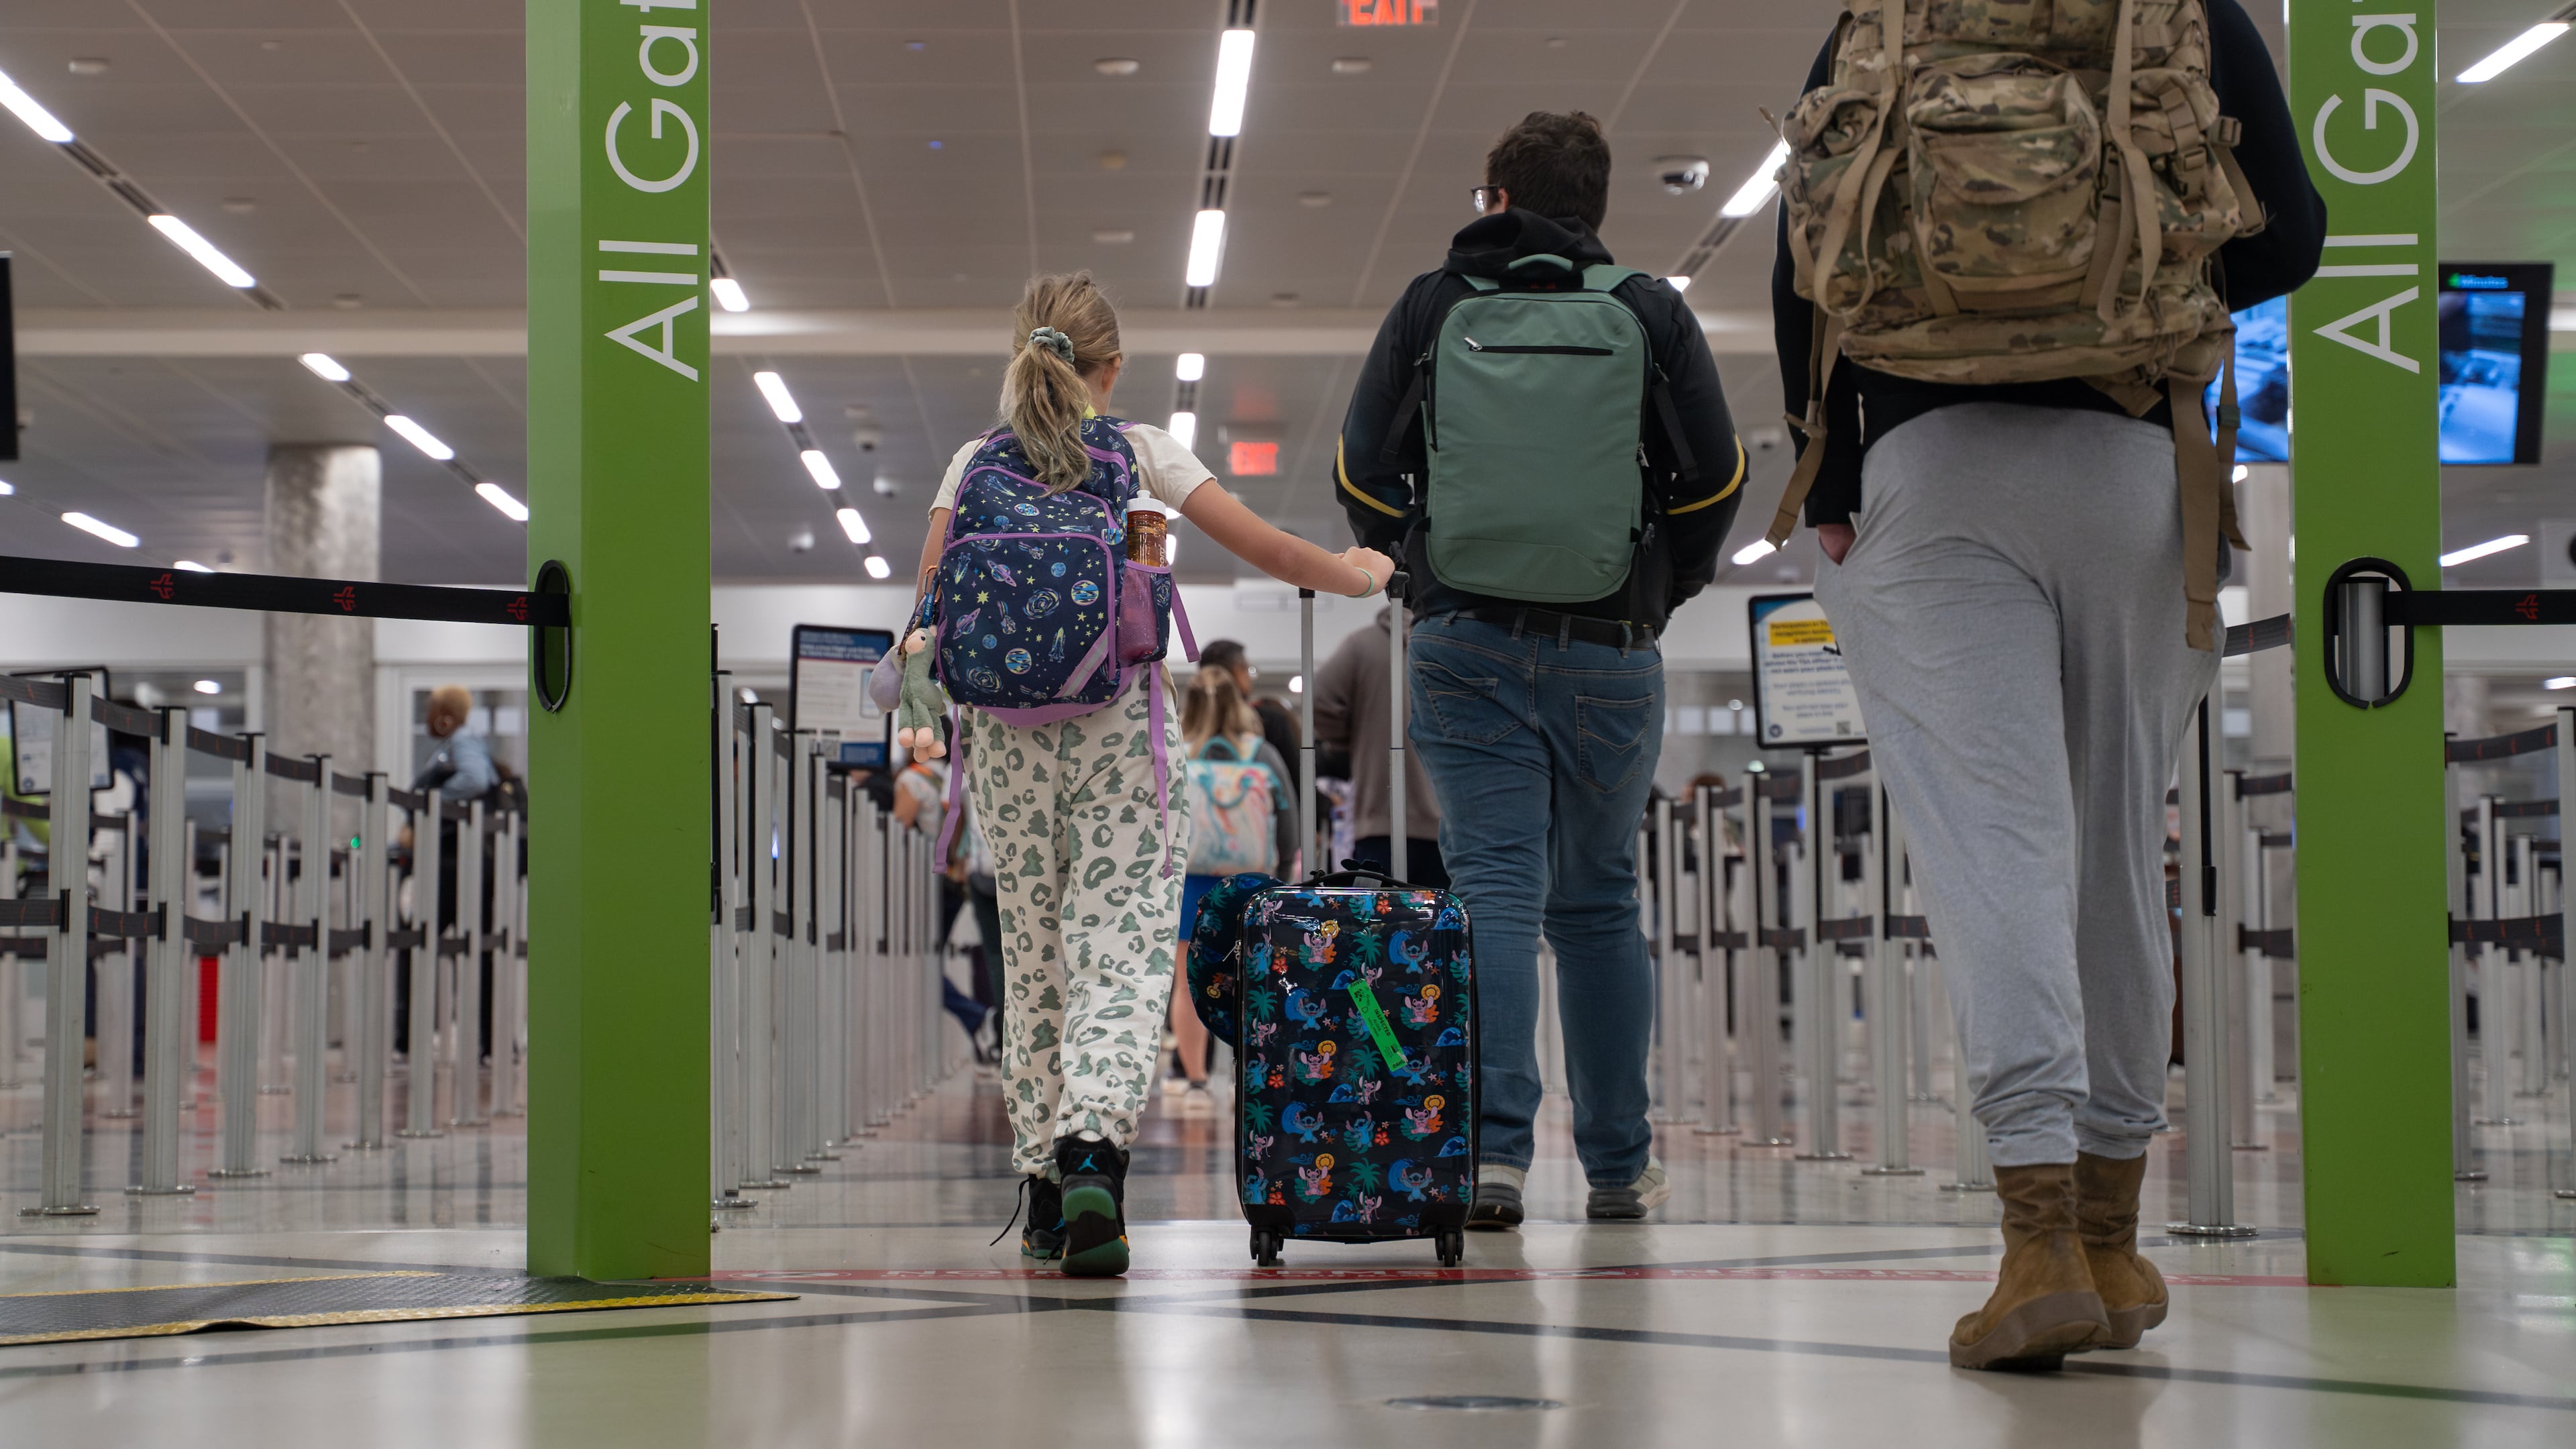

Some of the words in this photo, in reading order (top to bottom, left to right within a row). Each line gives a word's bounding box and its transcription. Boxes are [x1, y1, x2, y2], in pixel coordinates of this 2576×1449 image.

[2312, 0, 2420, 184] Ga
[598, 239, 698, 382] All
[2312, 233, 2420, 374] All
[1374, 1008, 1391, 1036] INSPECTED
